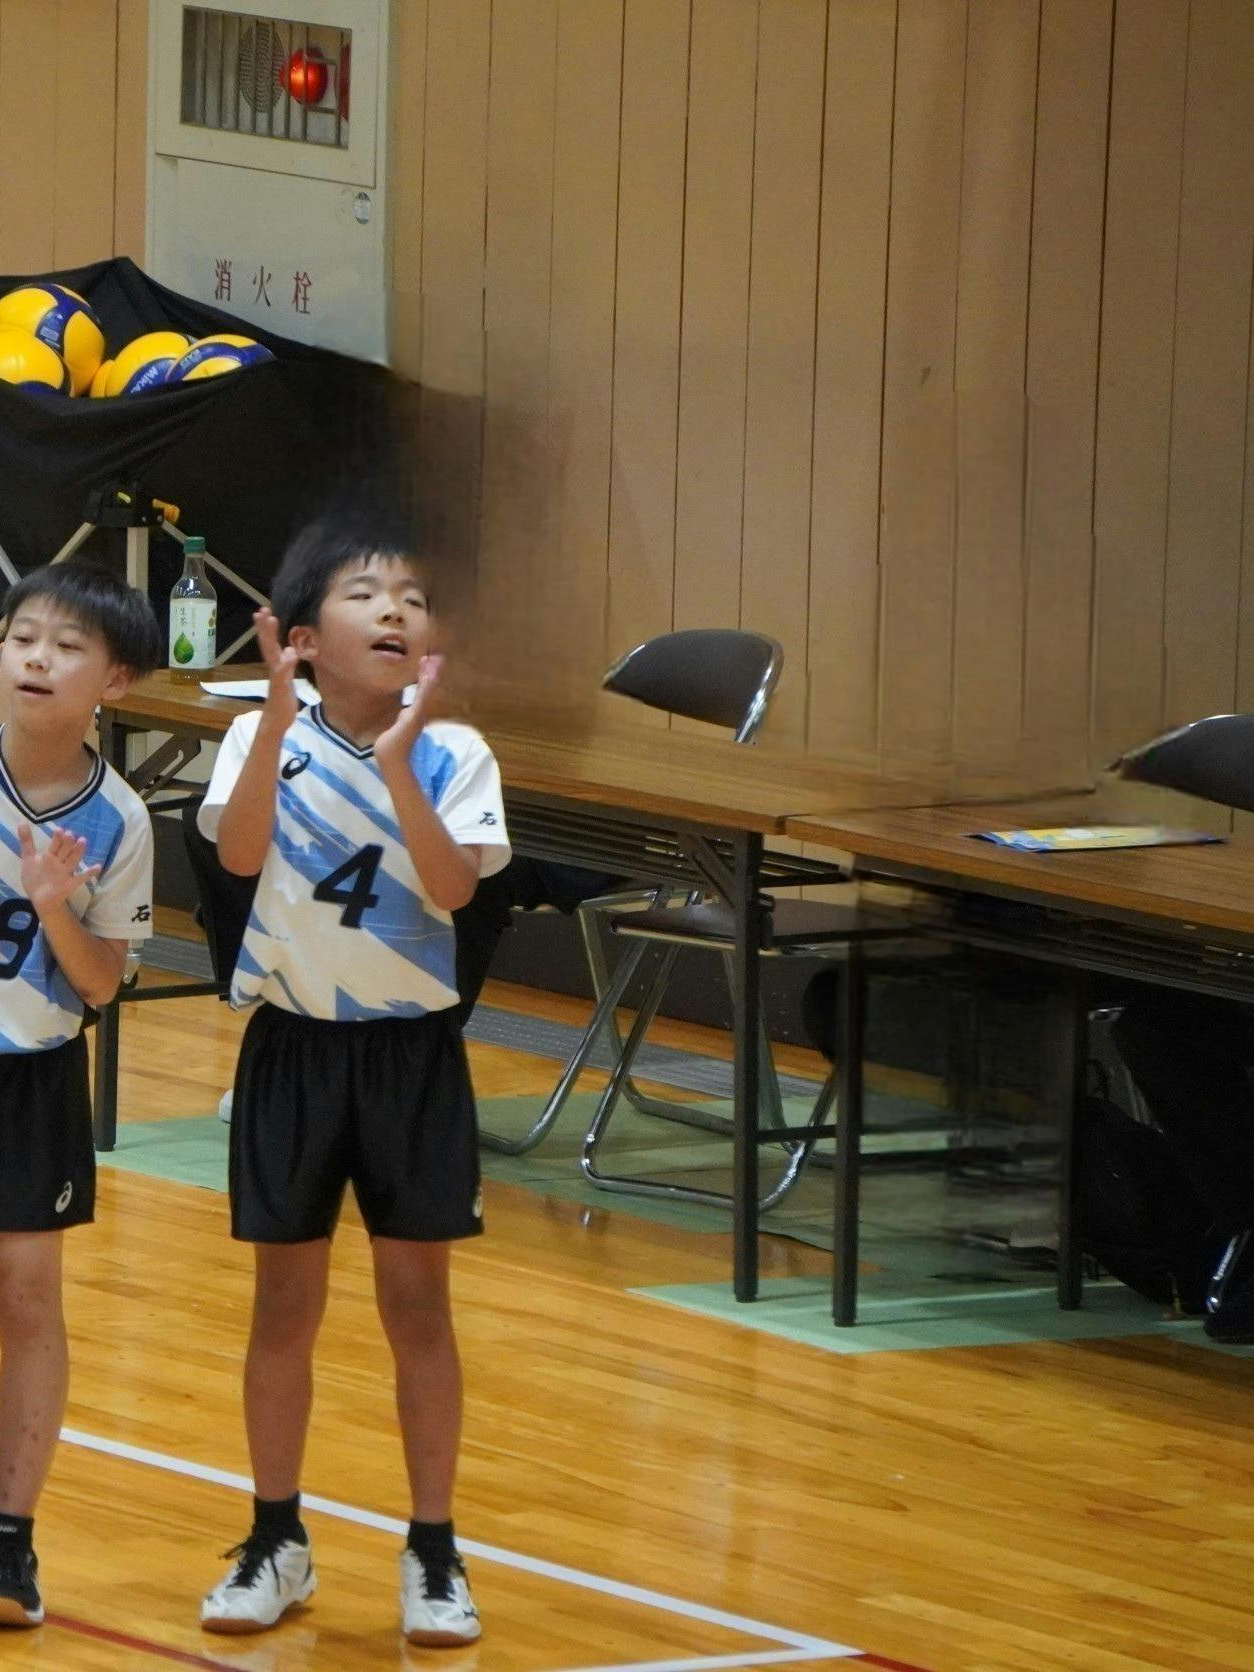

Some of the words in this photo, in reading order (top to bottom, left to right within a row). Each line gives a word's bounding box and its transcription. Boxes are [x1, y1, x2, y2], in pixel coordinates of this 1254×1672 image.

[215, 258, 313, 315] 消火栓
[131, 904, 151, 923] 石
[313, 843, 384, 930] 4
